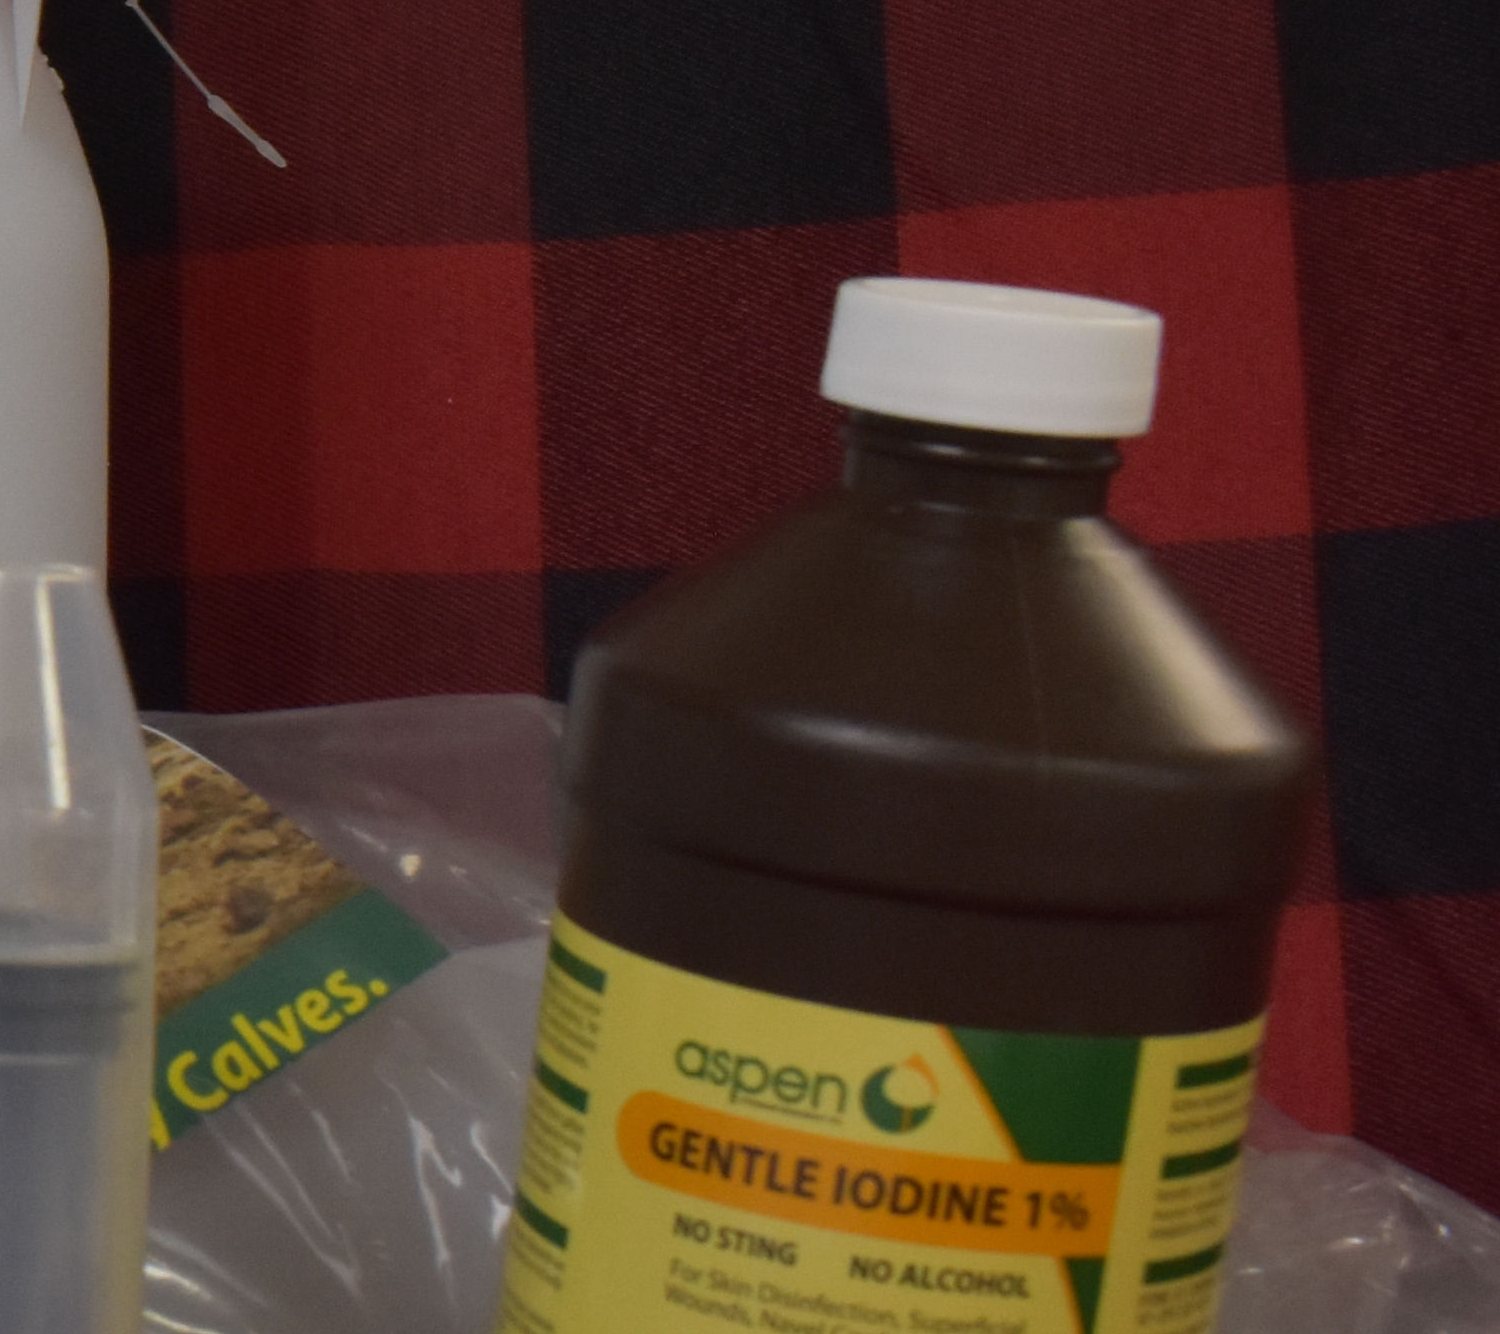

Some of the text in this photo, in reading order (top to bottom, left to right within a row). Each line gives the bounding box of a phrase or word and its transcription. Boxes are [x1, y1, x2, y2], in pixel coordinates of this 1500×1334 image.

[167, 969, 389, 1112] Calves.
[674, 1040, 848, 1114] aspen
[649, 1121, 818, 1205] GENTLE
[831, 1166, 1006, 1230] IODINE
[1025, 1184, 1091, 1232] 1%
[673, 1212, 1030, 1299] NO STING NO ALCOHOL
